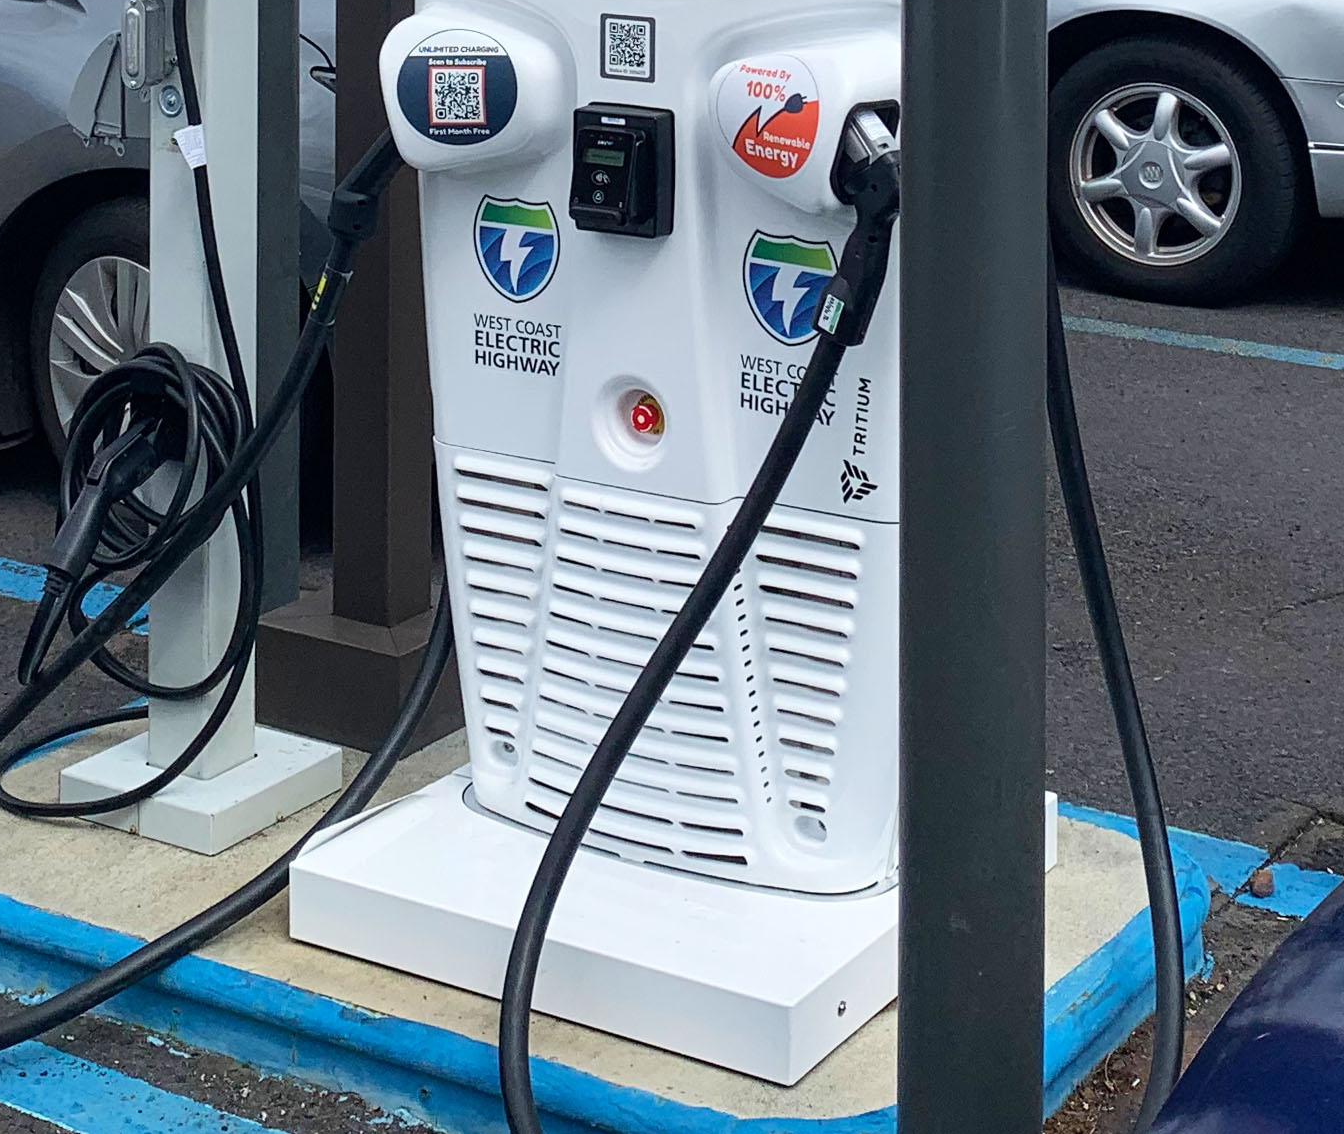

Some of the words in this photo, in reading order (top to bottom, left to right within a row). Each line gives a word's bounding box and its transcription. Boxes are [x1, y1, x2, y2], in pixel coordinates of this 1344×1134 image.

[418, 46, 459, 54] UNLIMITED
[460, 46, 499, 54] CHARGING
[428, 58, 445, 66] Scan
[454, 58, 487, 66] Subscribe
[739, 64, 778, 78] Powered
[779, 70, 792, 82] By
[746, 80, 786, 102] 100%
[762, 131, 811, 150] Renewable
[744, 138, 799, 169] Energy
[474, 313, 512, 331] WEST
[515, 319, 562, 338] COAST
[475, 329, 561, 358] ELECTRIC
[475, 349, 560, 377] HIGHWAY
[740, 354, 782, 376] WEST
[741, 372, 836, 407] ELECTC
[852, 377, 872, 456] TRITIUM
